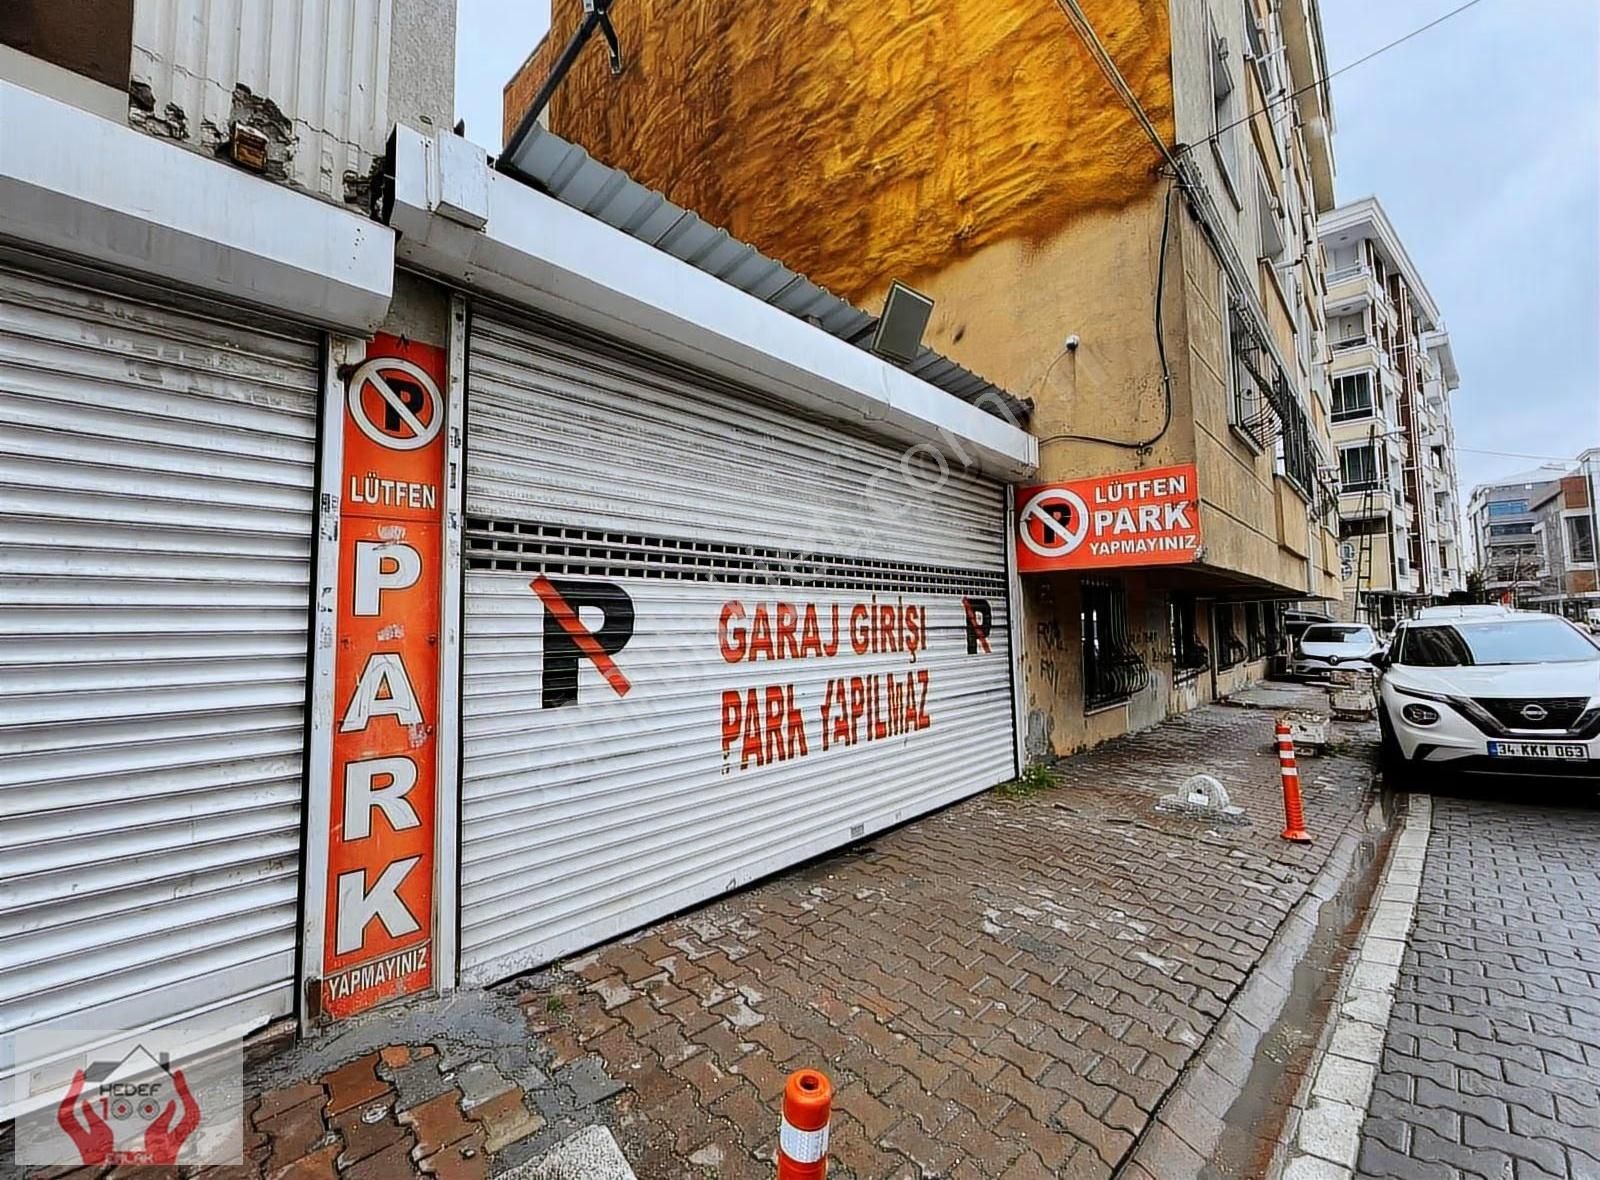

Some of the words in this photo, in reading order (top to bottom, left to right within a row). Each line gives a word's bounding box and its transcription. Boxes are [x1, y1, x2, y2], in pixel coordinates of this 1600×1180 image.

[351, 472, 436, 509] LÜTFEN
[1095, 475, 1186, 503] LÜTFEN
[1094, 501, 1193, 536] PARK
[1089, 534, 1197, 556] YAPMAYINIZ
[719, 599, 840, 664] GARAJ
[721, 683, 808, 776] PARK
[1498, 744, 1515, 755] 34
[1554, 745, 1584, 758] 063
[328, 947, 428, 1001] YAPMAYINIZ
